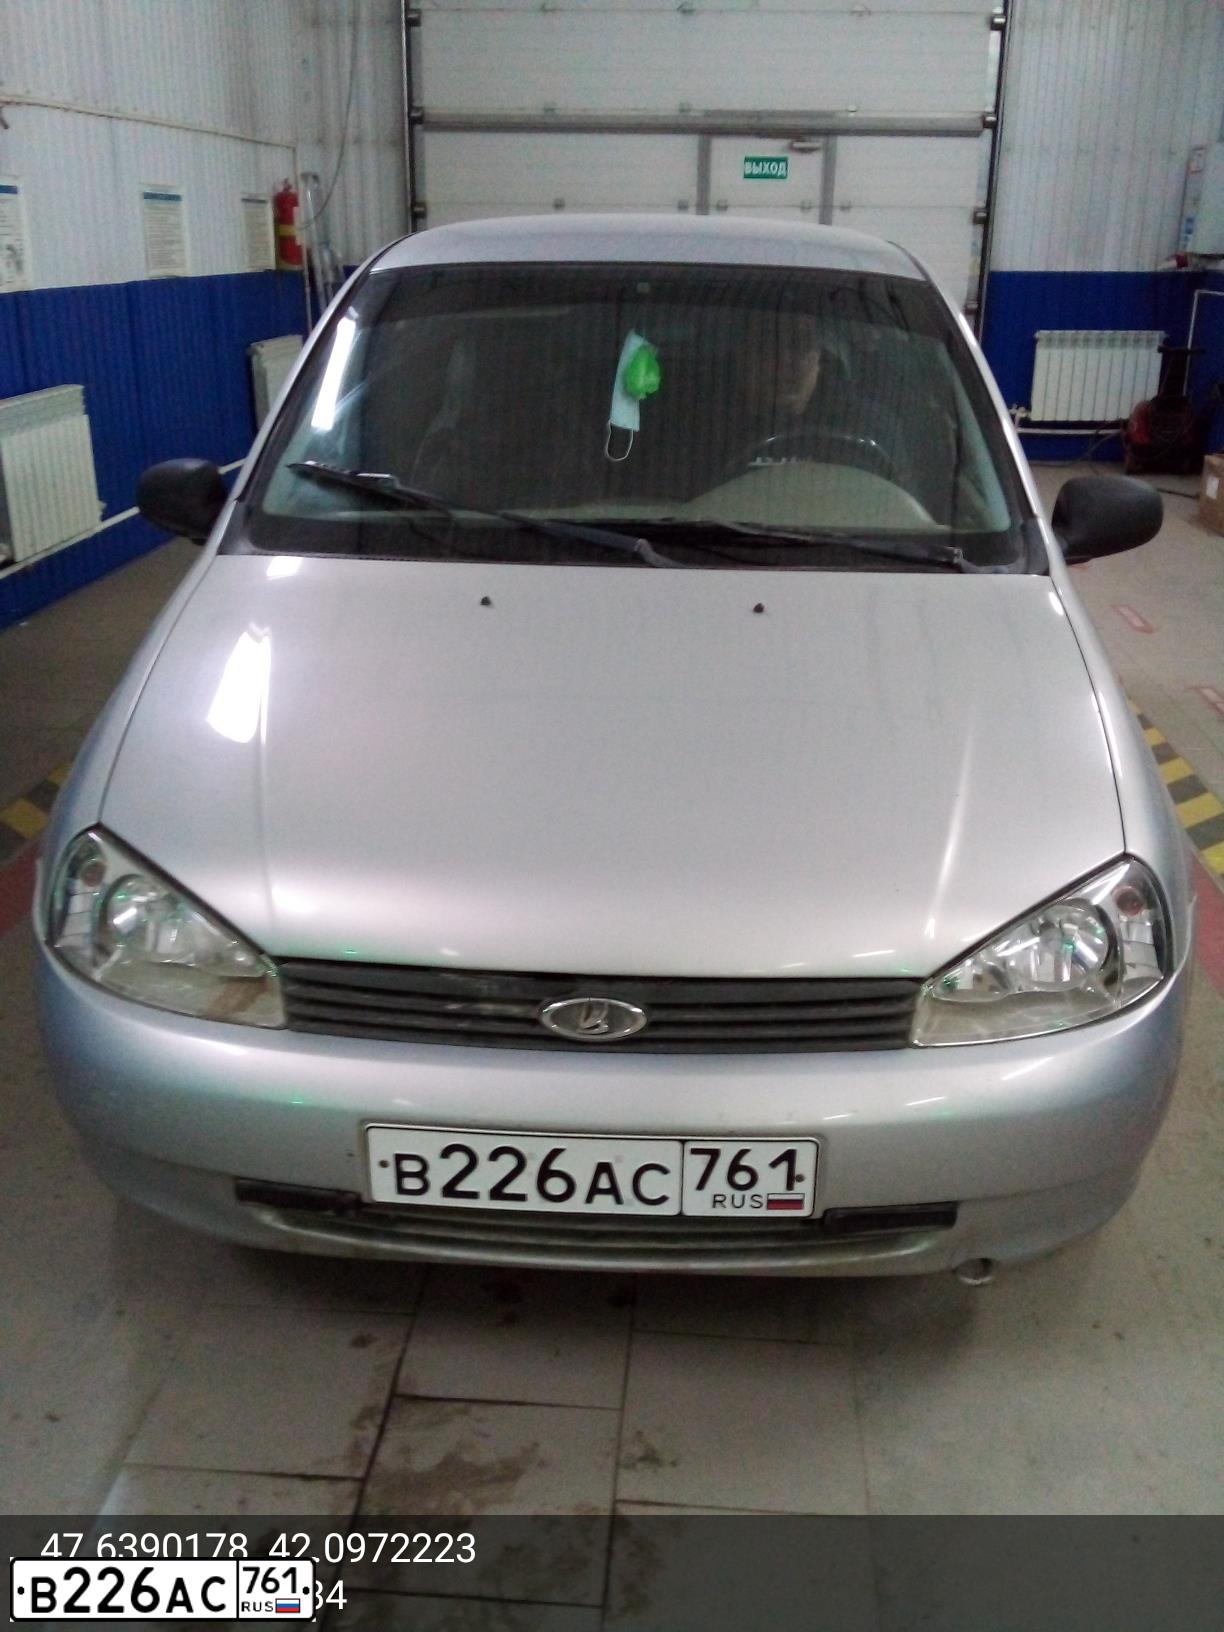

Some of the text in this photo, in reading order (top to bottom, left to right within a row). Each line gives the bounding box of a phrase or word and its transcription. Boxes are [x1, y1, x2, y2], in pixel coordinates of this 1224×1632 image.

[744, 161, 787, 177] ВЫХОД
[690, 1147, 799, 1192] 761
[711, 1193, 764, 1210] RUS
